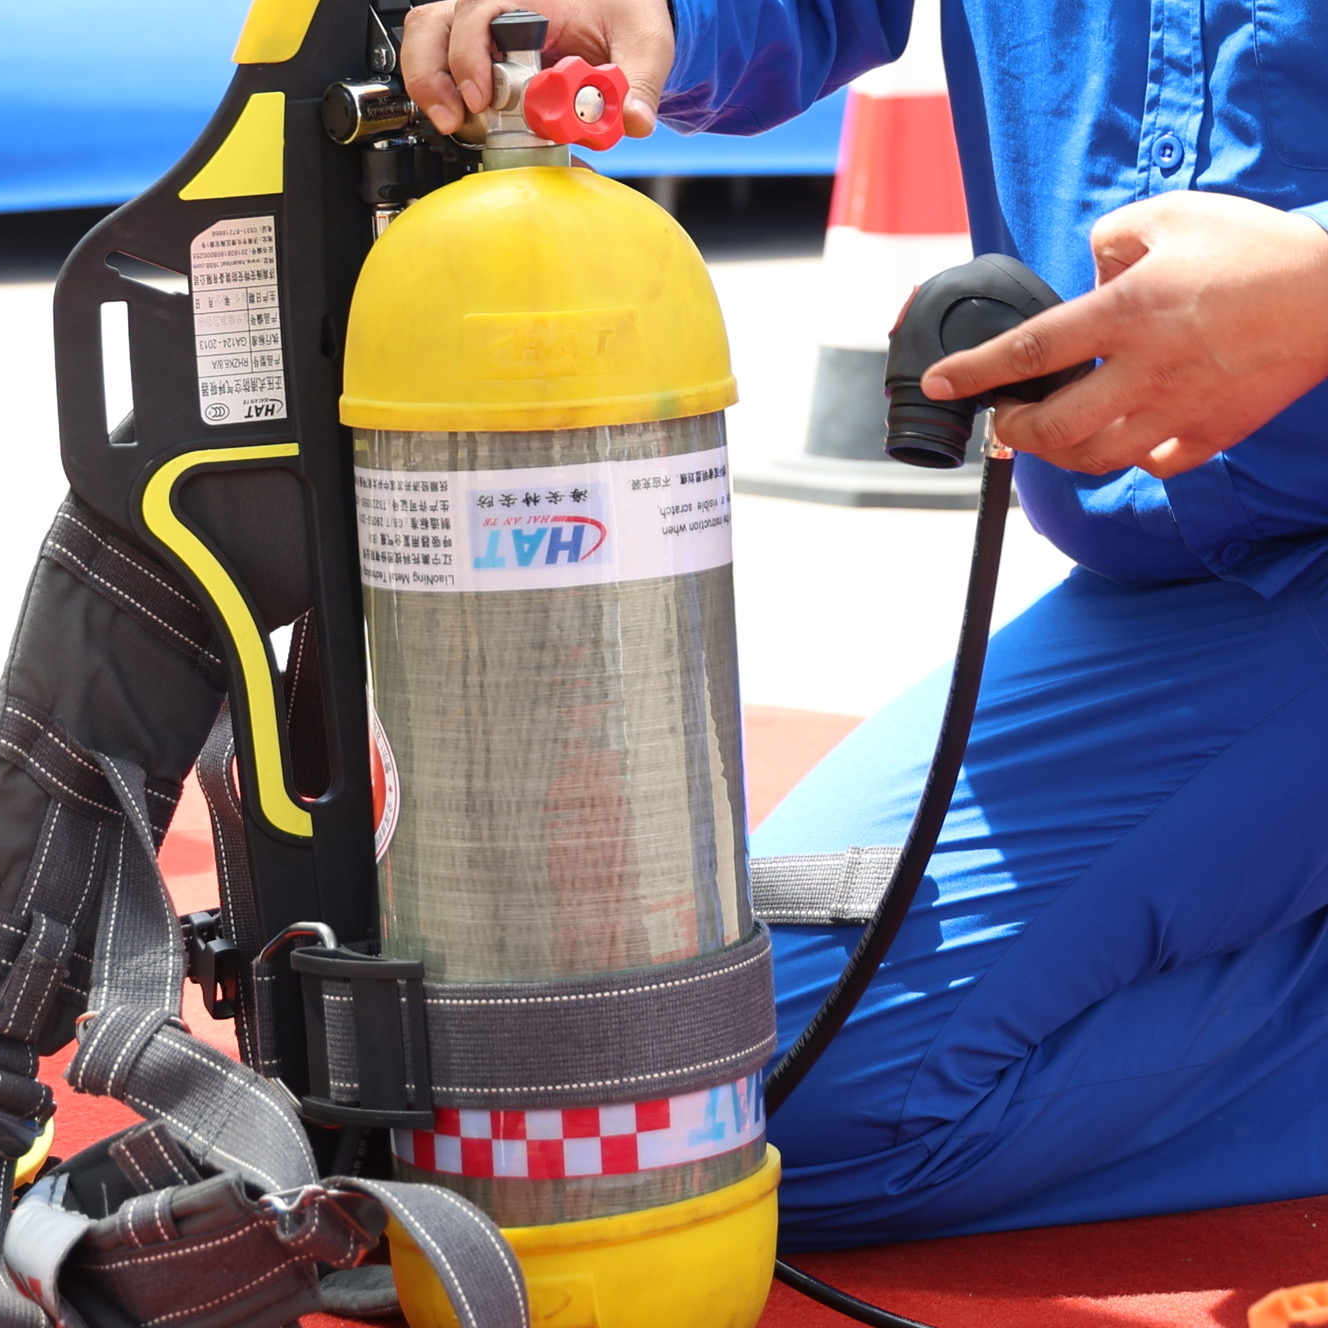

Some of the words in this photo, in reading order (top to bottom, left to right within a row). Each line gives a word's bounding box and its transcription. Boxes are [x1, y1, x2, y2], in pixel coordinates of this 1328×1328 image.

[199, 336, 247, 350] GA124-2013
[253, 355, 280, 367] 产品型号
[201, 376, 282, 396] 正压式消防空气呼吸器
[244, 403, 275, 418] HAT
[476, 488, 588, 509] 海安特安防
[661, 524, 687, 536] when
[474, 525, 585, 568] HAT
[413, 572, 454, 586] LiaoNing
